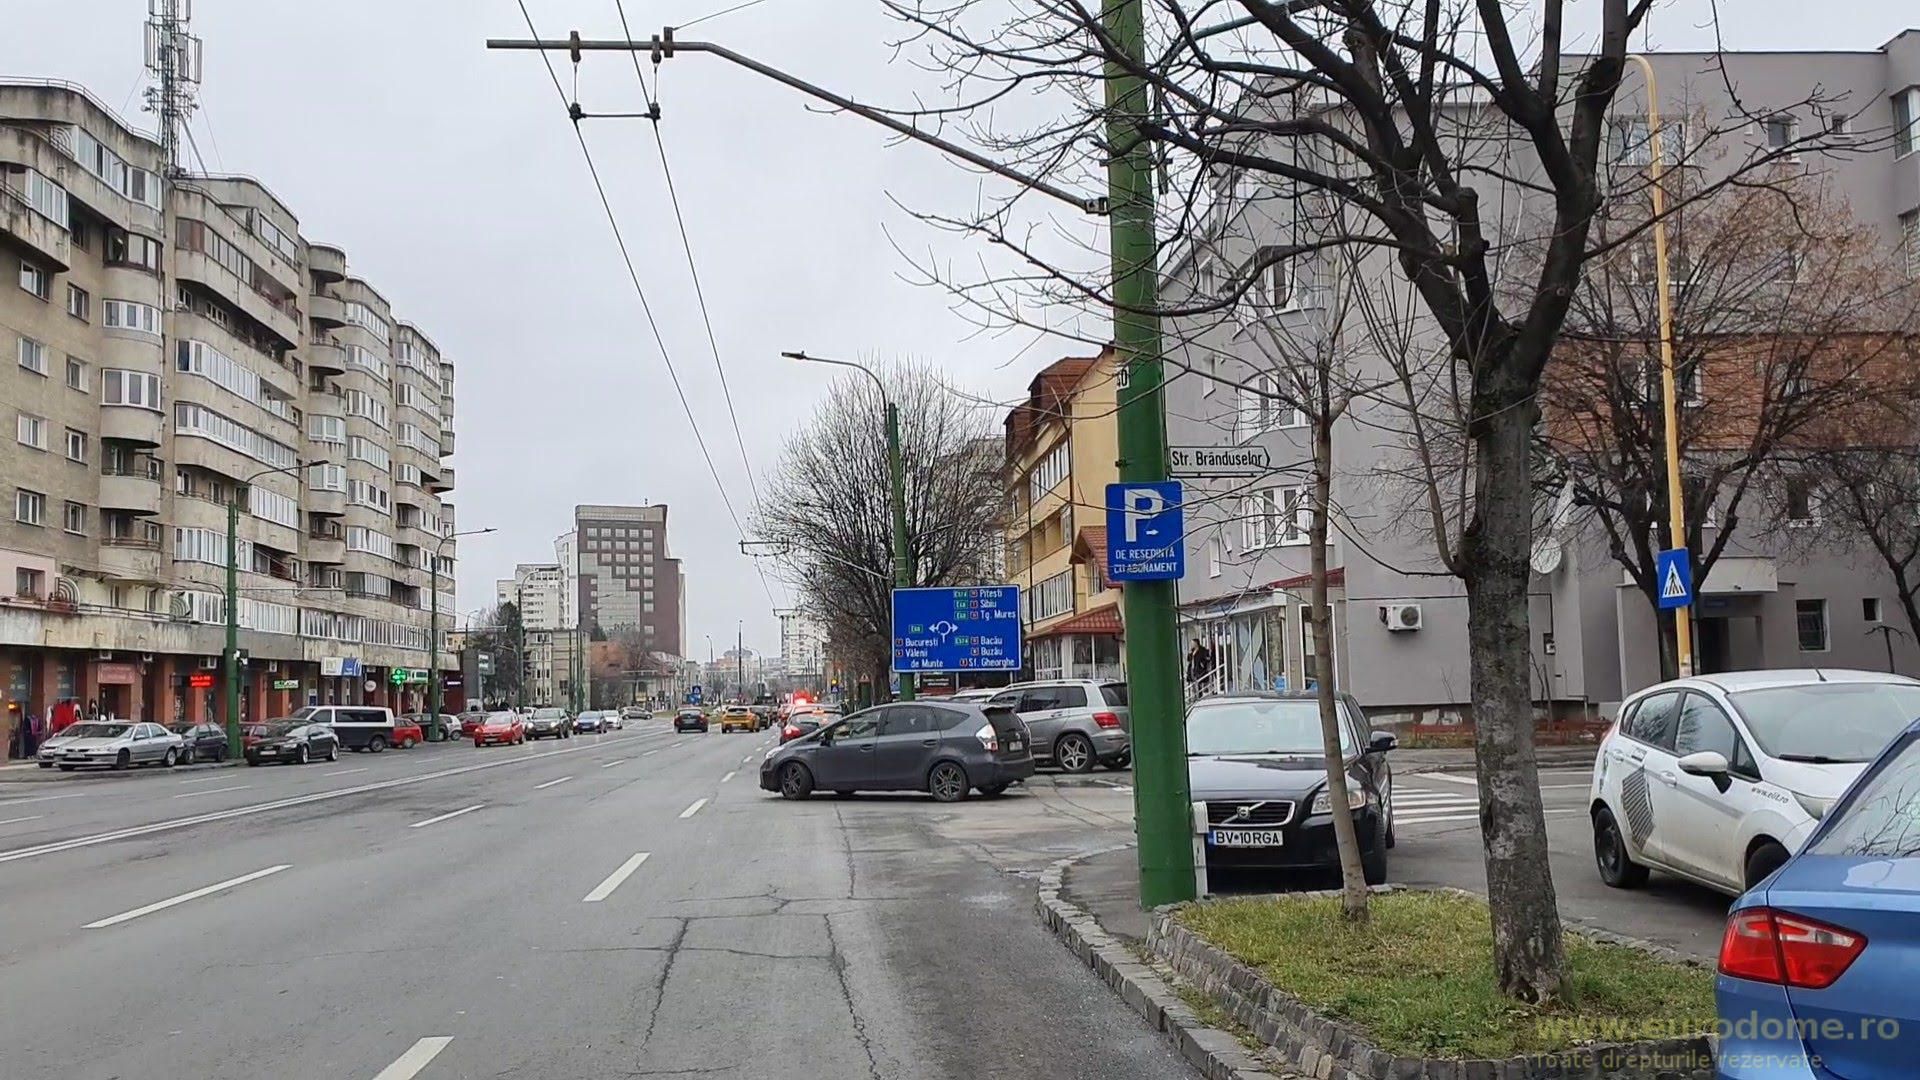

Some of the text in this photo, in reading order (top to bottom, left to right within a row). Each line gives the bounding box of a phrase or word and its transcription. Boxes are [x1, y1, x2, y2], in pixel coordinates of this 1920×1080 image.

[1172, 450, 1192, 466] Str.
[1124, 488, 1164, 543] P
[1115, 549, 1127, 560] DE
[979, 599, 997, 608] Sibiu
[910, 658, 944, 668] de Munte
[981, 656, 1015, 668] Gheorghe
